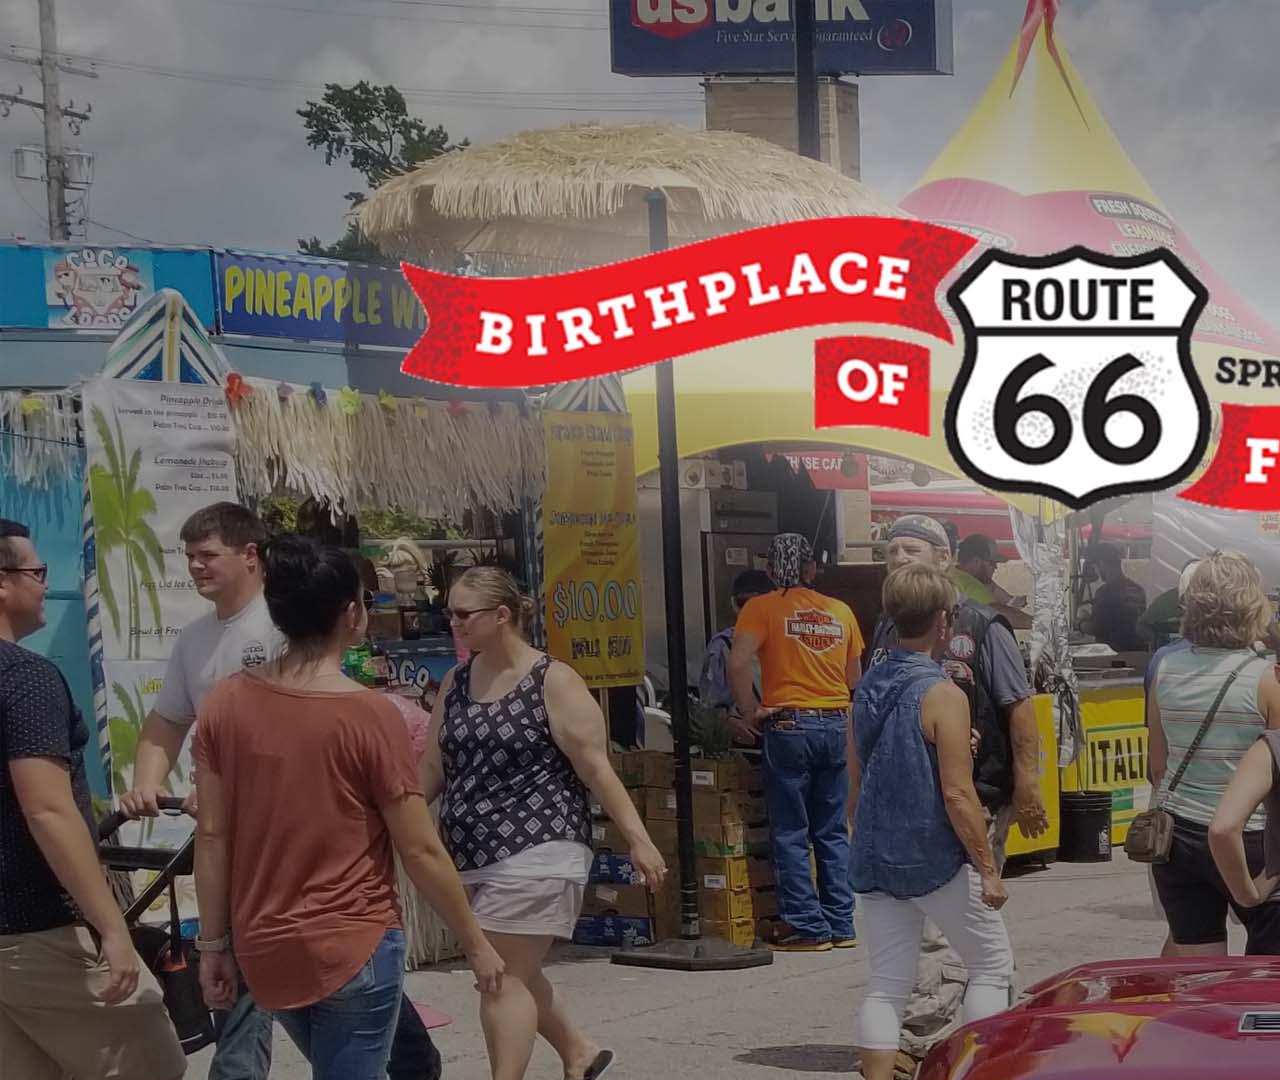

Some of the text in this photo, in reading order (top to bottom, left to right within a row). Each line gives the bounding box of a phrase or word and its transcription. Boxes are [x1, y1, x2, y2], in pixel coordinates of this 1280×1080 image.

[716, 29, 873, 43] Five Star Serv uaranteed
[1092, 199, 1133, 215] FRESH
[224, 265, 382, 325] PINEAPPLE
[154, 456, 197, 466] Lemonade
[552, 579, 639, 629] $10.00
[1090, 736, 1144, 785] ITALI
